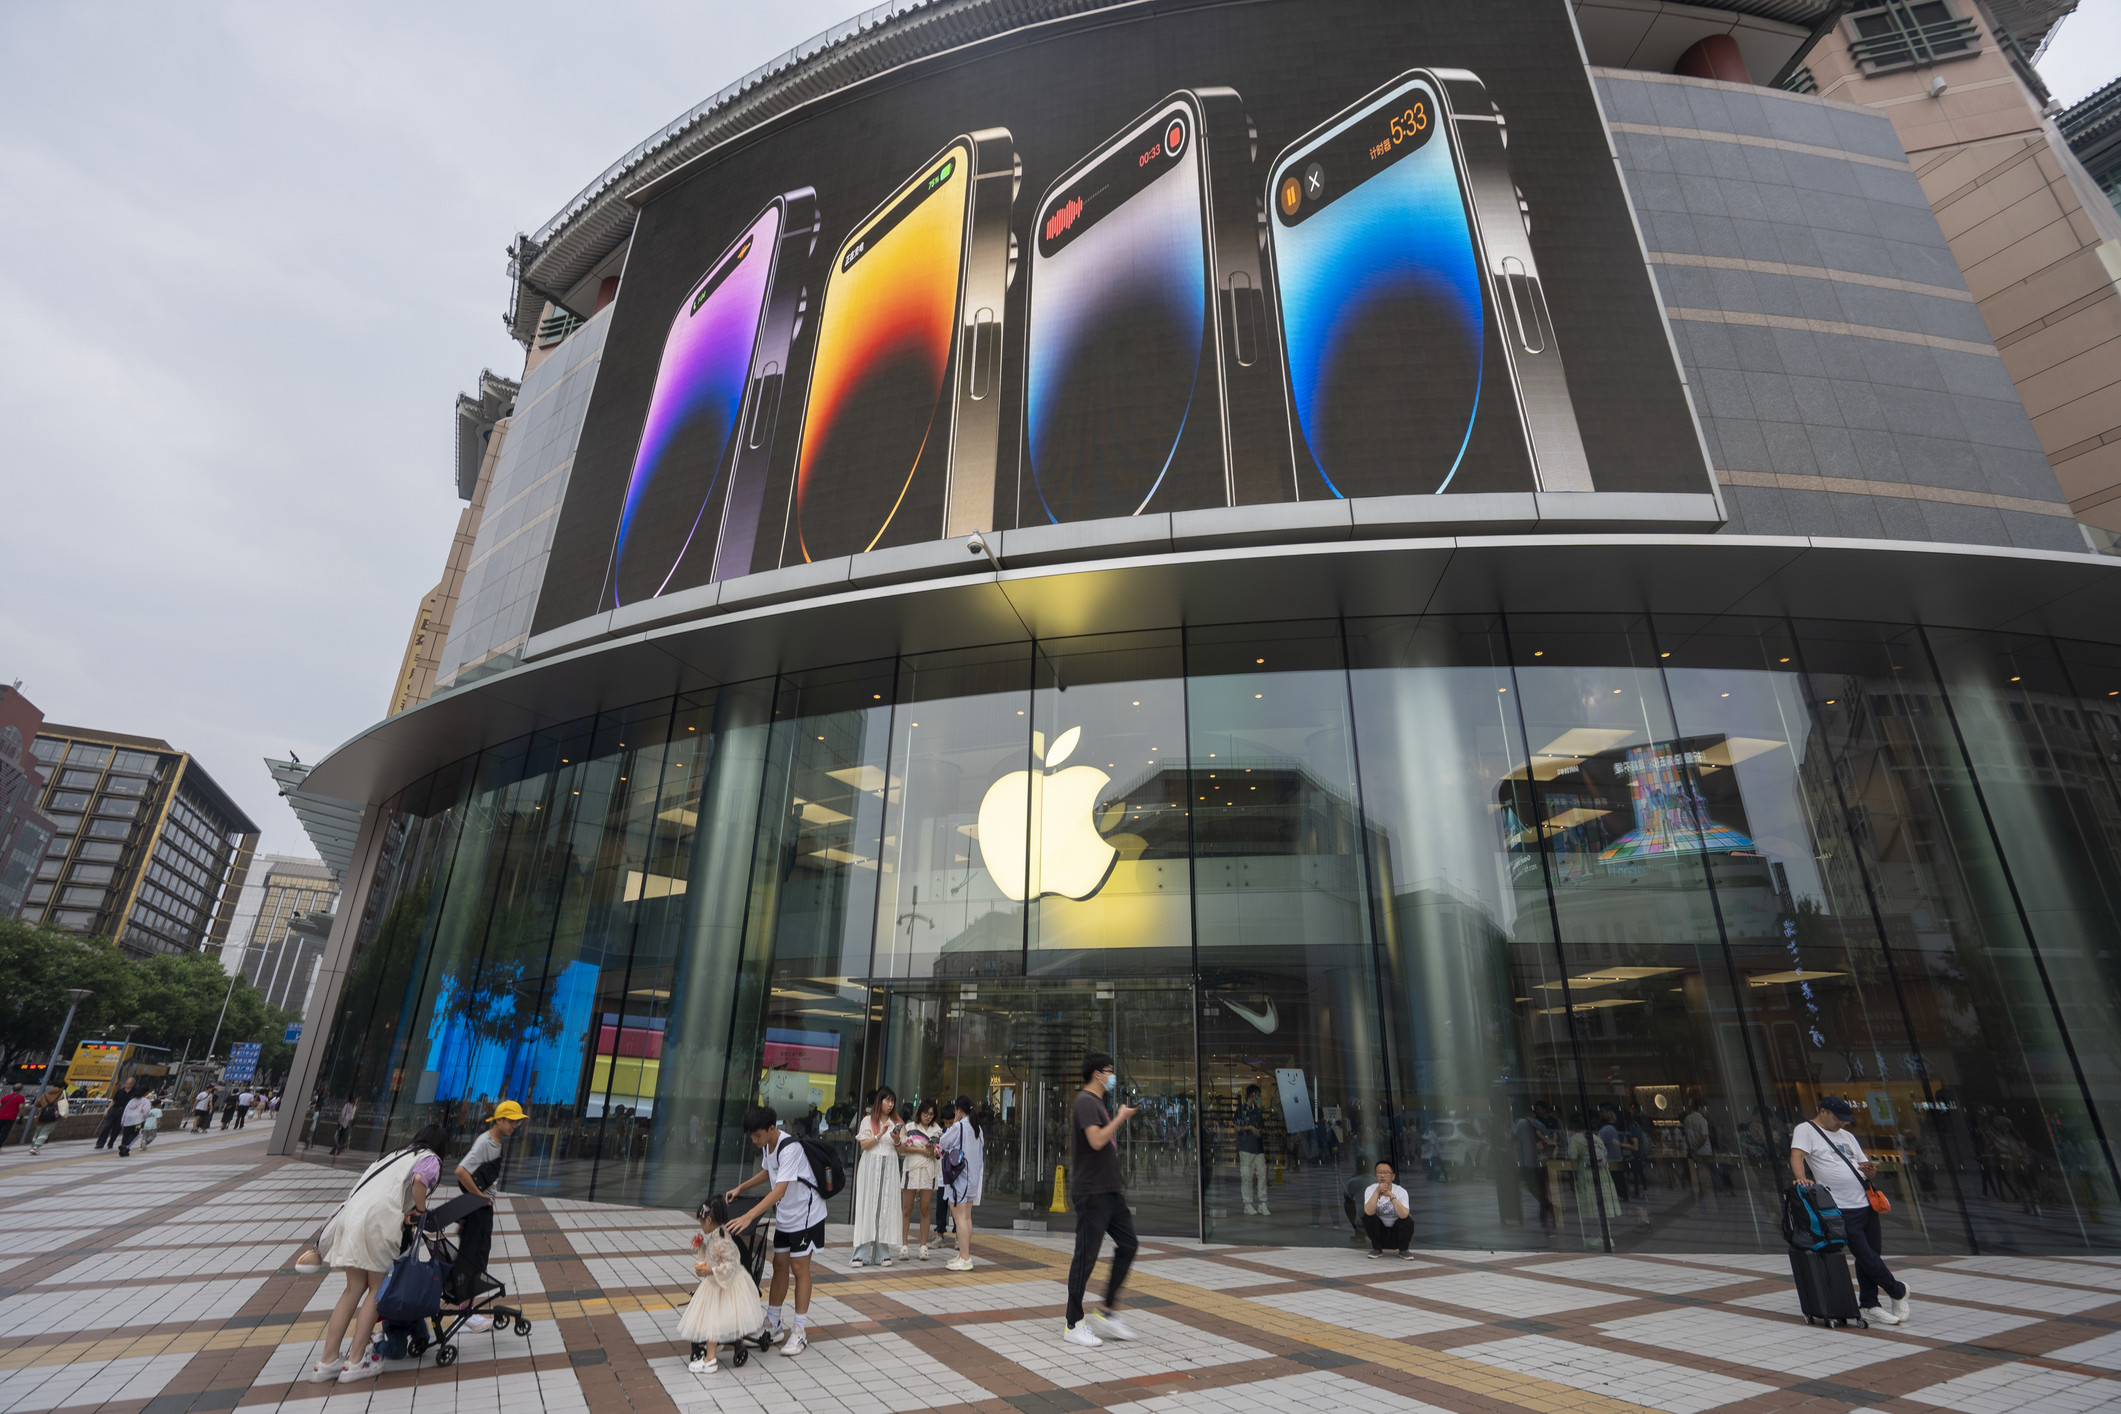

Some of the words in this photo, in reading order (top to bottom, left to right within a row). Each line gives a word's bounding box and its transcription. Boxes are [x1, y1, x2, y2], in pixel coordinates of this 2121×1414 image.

[1369, 138, 1391, 160] 计时器
[1390, 102, 1427, 145] 5:33
[1139, 143, 1161, 167] 00:33
